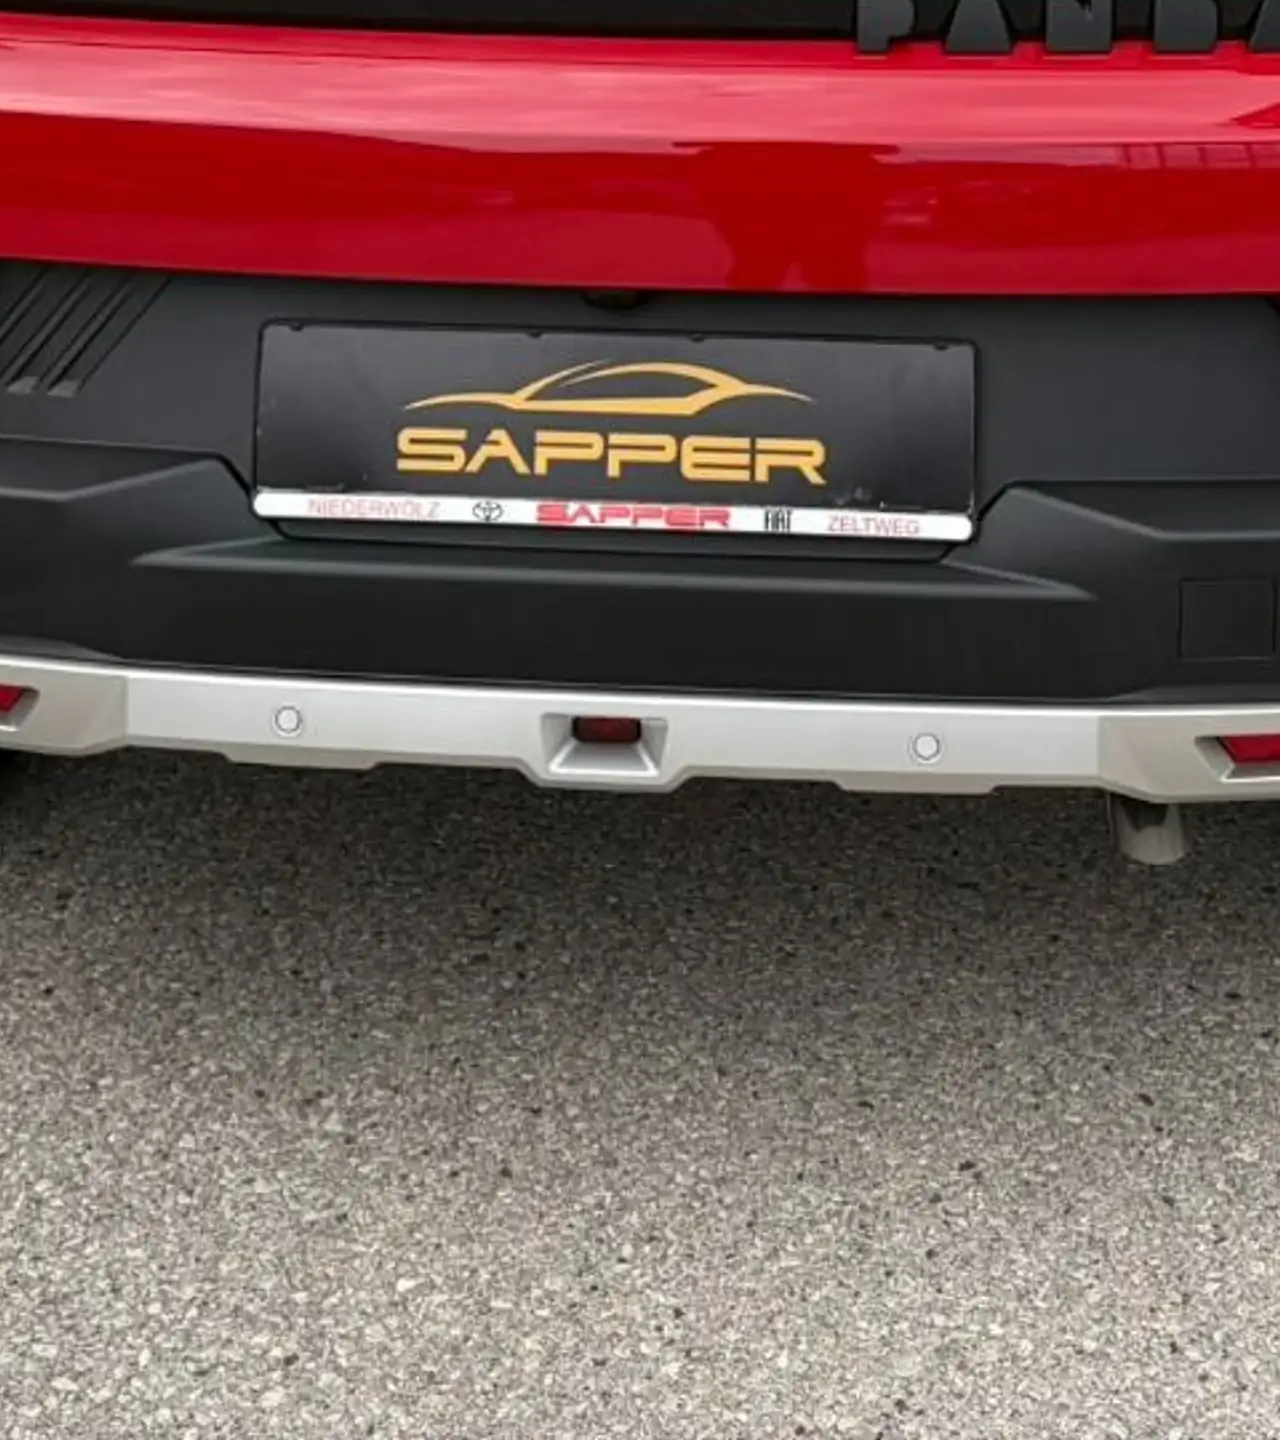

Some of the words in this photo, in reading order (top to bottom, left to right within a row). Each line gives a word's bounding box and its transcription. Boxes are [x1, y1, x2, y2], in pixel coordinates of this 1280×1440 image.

[396, 427, 827, 486] SAPPER
[536, 503, 732, 530] SAPPER
[827, 515, 921, 536] ZELTWEG
